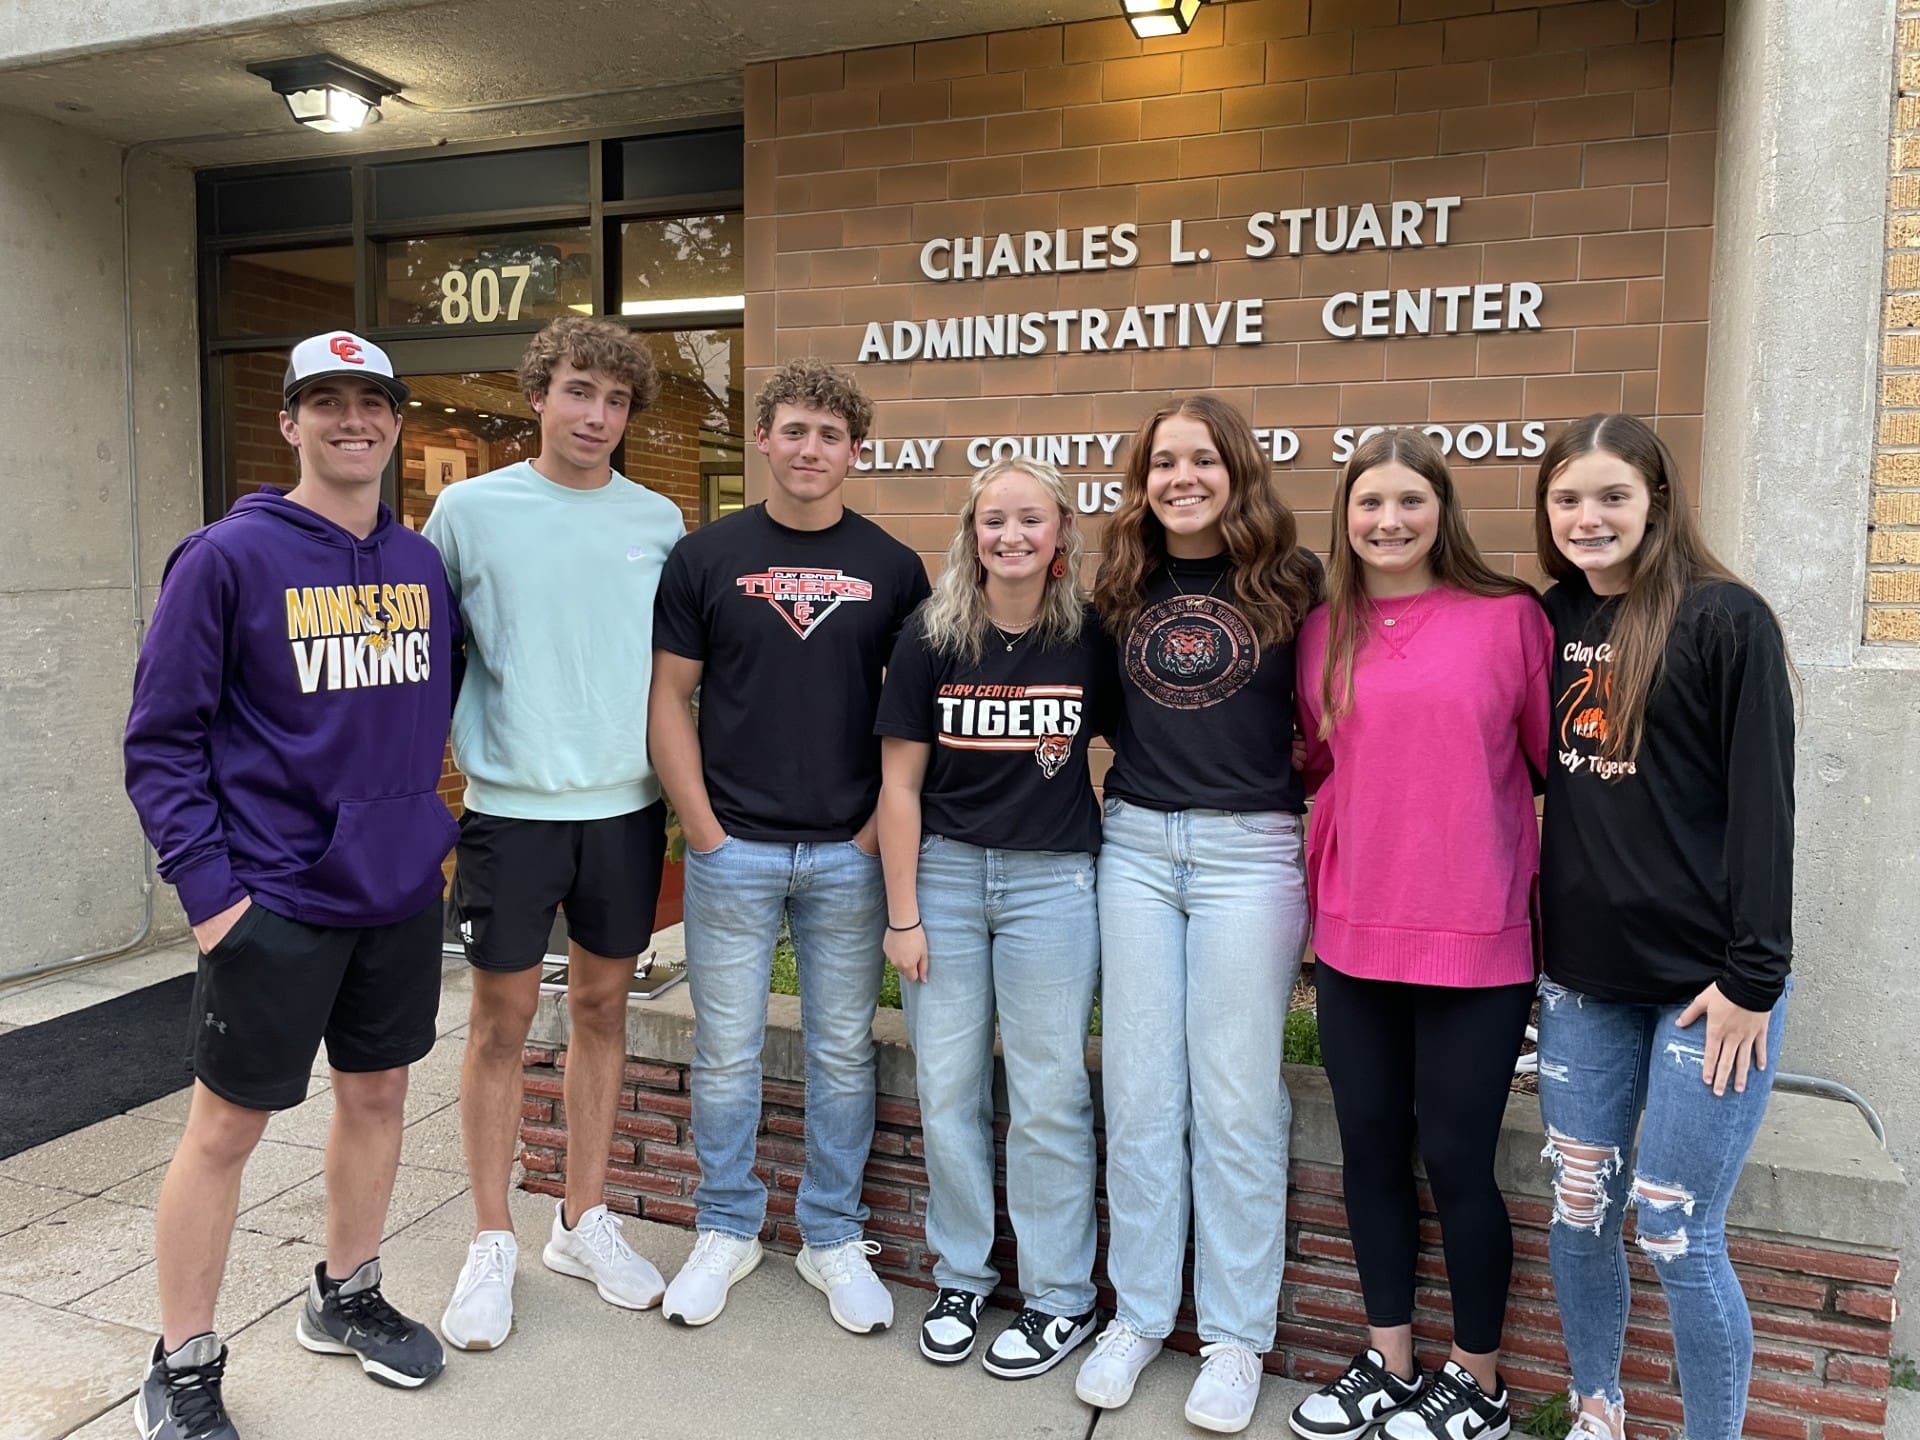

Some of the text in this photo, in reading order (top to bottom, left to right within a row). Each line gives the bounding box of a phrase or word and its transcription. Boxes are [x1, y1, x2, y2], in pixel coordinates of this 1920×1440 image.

[920, 196, 1461, 281] CHARLES L. STUART
[441, 265, 530, 325] 807
[857, 282, 1544, 362] ADMINISTRATIVE CENTER
[854, 439, 943, 471] CLAY
[966, 434, 1122, 469] COUNTY
[1332, 422, 1546, 462] SOOLS
[736, 577, 873, 600] TIGERS
[774, 594, 835, 602] BASEBALL
[285, 584, 430, 640] MINNESOTA
[1215, 607, 1251, 646] TIGERS
[291, 632, 431, 693] VIKINGS
[1563, 640, 1594, 668] Clay
[938, 684, 1026, 698] CLAY CENTER
[937, 697, 1083, 736] TIGERS
[1588, 755, 1637, 780] Tigers
